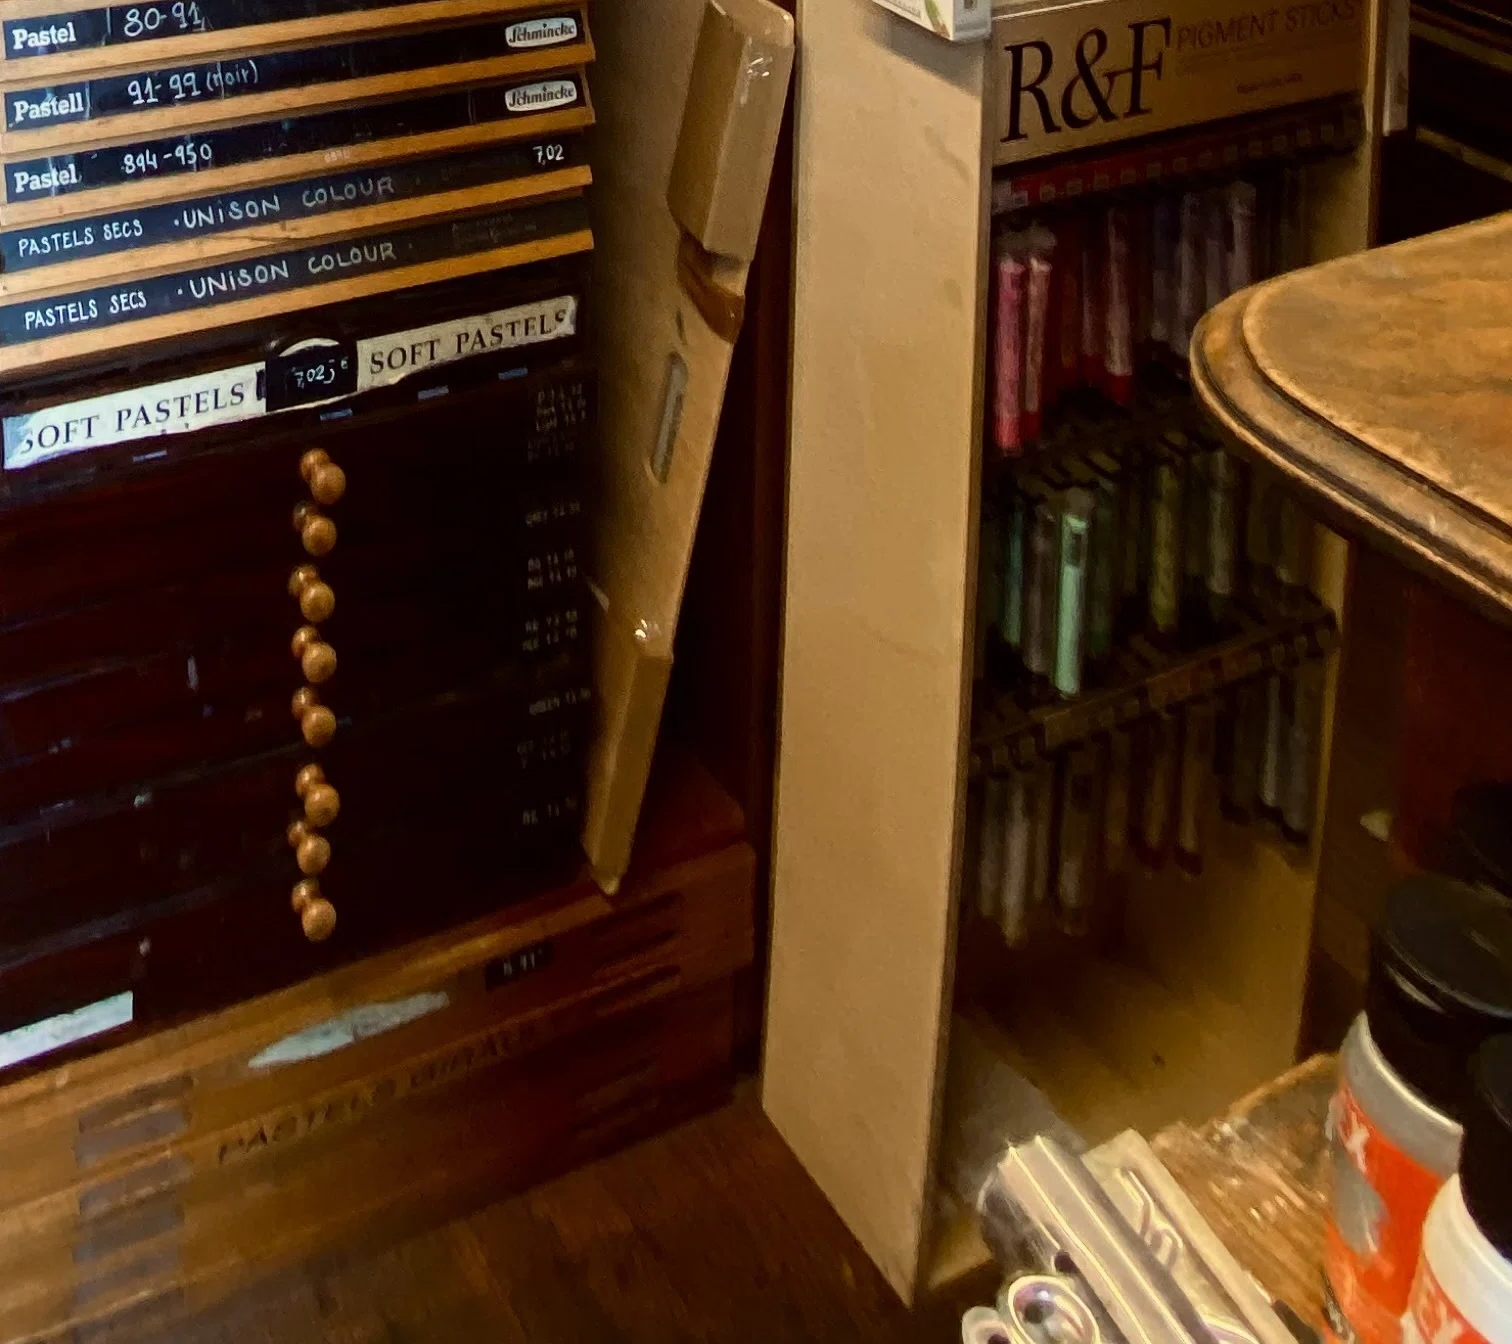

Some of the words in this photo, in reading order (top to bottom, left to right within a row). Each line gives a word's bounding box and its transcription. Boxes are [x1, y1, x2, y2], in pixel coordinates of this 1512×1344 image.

[12, 22, 76, 50] Pastel
[509, 22, 576, 43] Schmincke
[1178, 14, 1279, 51] PIGMENT
[14, 93, 85, 123] Pastell
[127, 72, 201, 105] 91-99
[509, 86, 576, 108] Schmincke
[1000, 17, 1172, 143] R&F
[532, 144, 565, 166] 7,02
[14, 165, 80, 193] Pastel
[19, 227, 94, 258] PASTELS
[103, 218, 143, 241] SECS
[302, 175, 395, 208] COLOUR
[25, 299, 98, 331] PASTELS
[109, 290, 148, 315] SECS
[308, 241, 397, 275] COLOUR
[370, 338, 441, 375] SOFT
[456, 307, 567, 354] PASTELS
[115, 382, 246, 433] PASTELS
